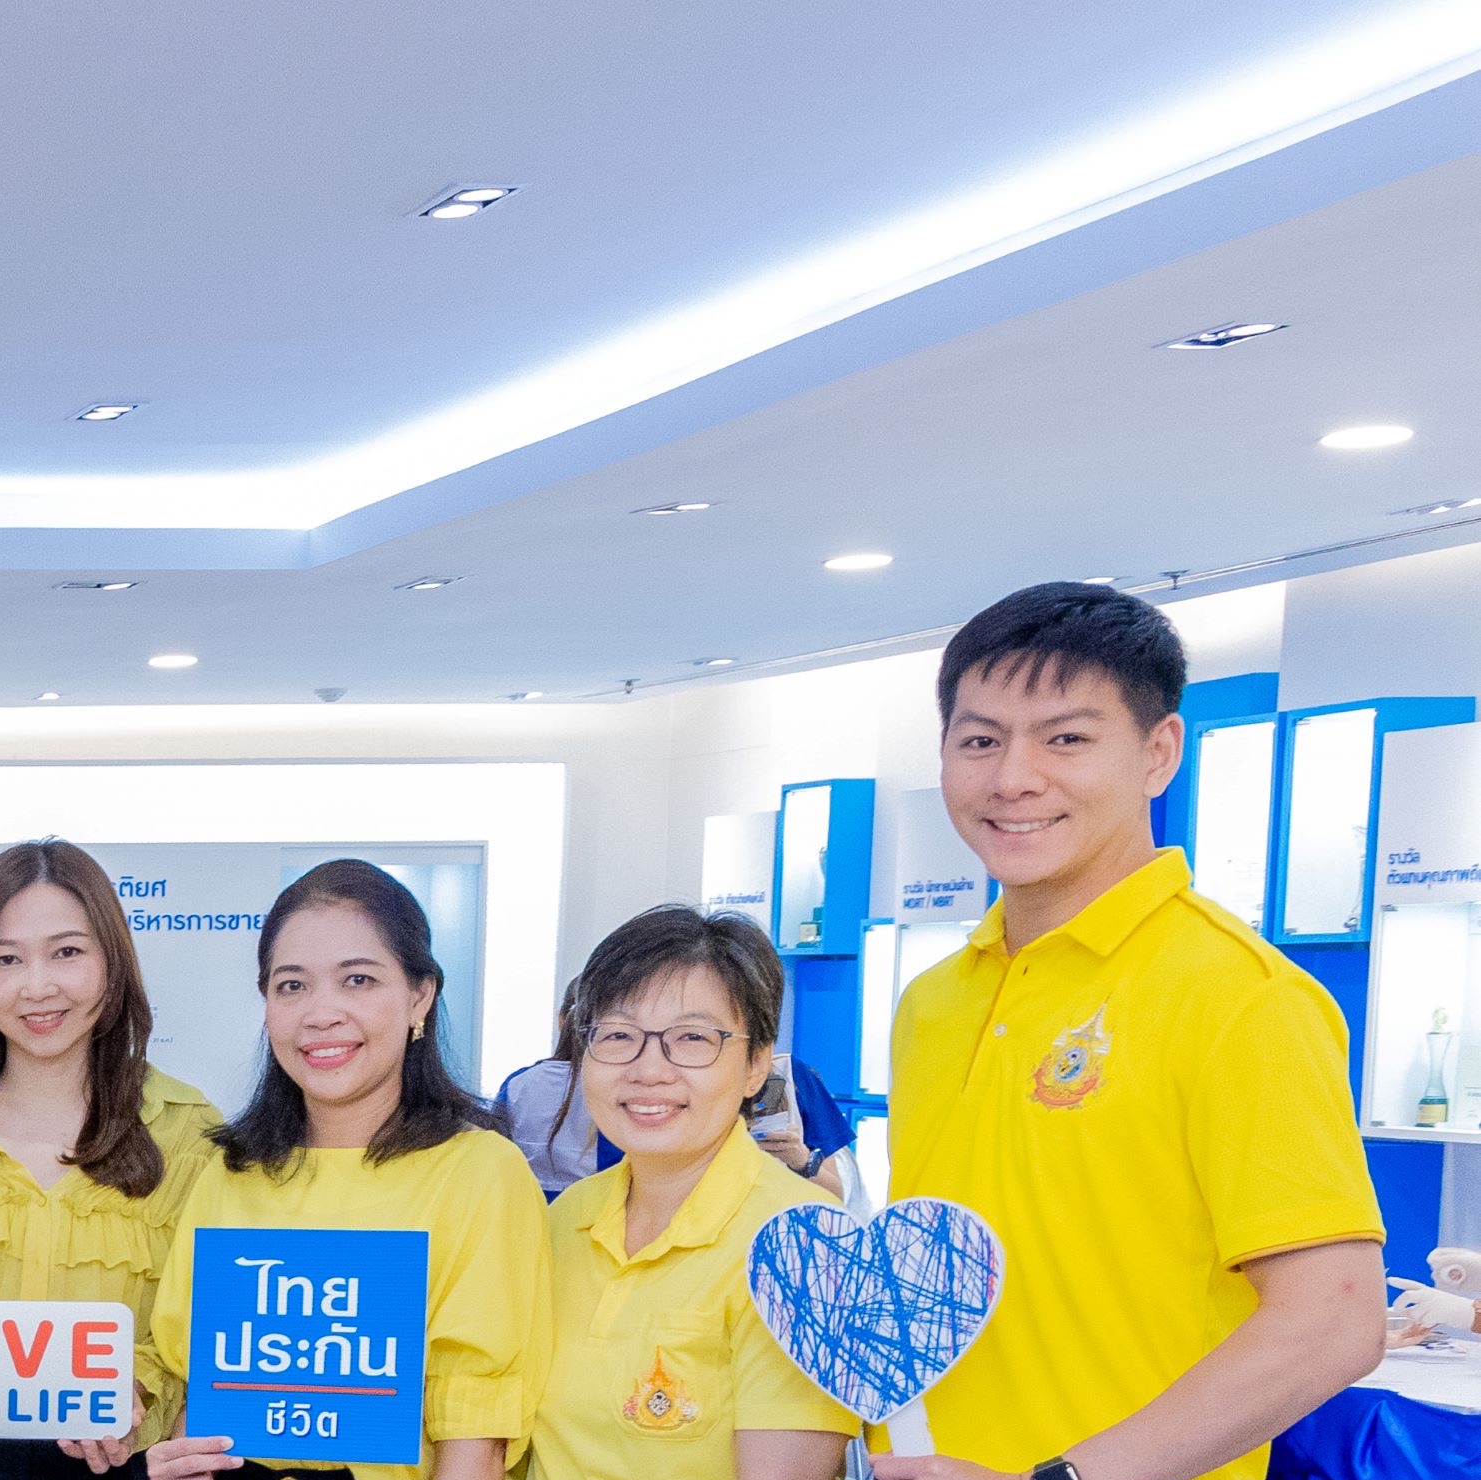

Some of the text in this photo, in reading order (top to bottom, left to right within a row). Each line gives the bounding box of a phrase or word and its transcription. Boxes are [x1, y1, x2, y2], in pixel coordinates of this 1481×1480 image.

[234, 1256, 359, 1317] ไทย
[215, 1321, 397, 1377] ประกัน
[8, 1388, 117, 1424] LIFE
[266, 1399, 338, 1438] ชีวิต
